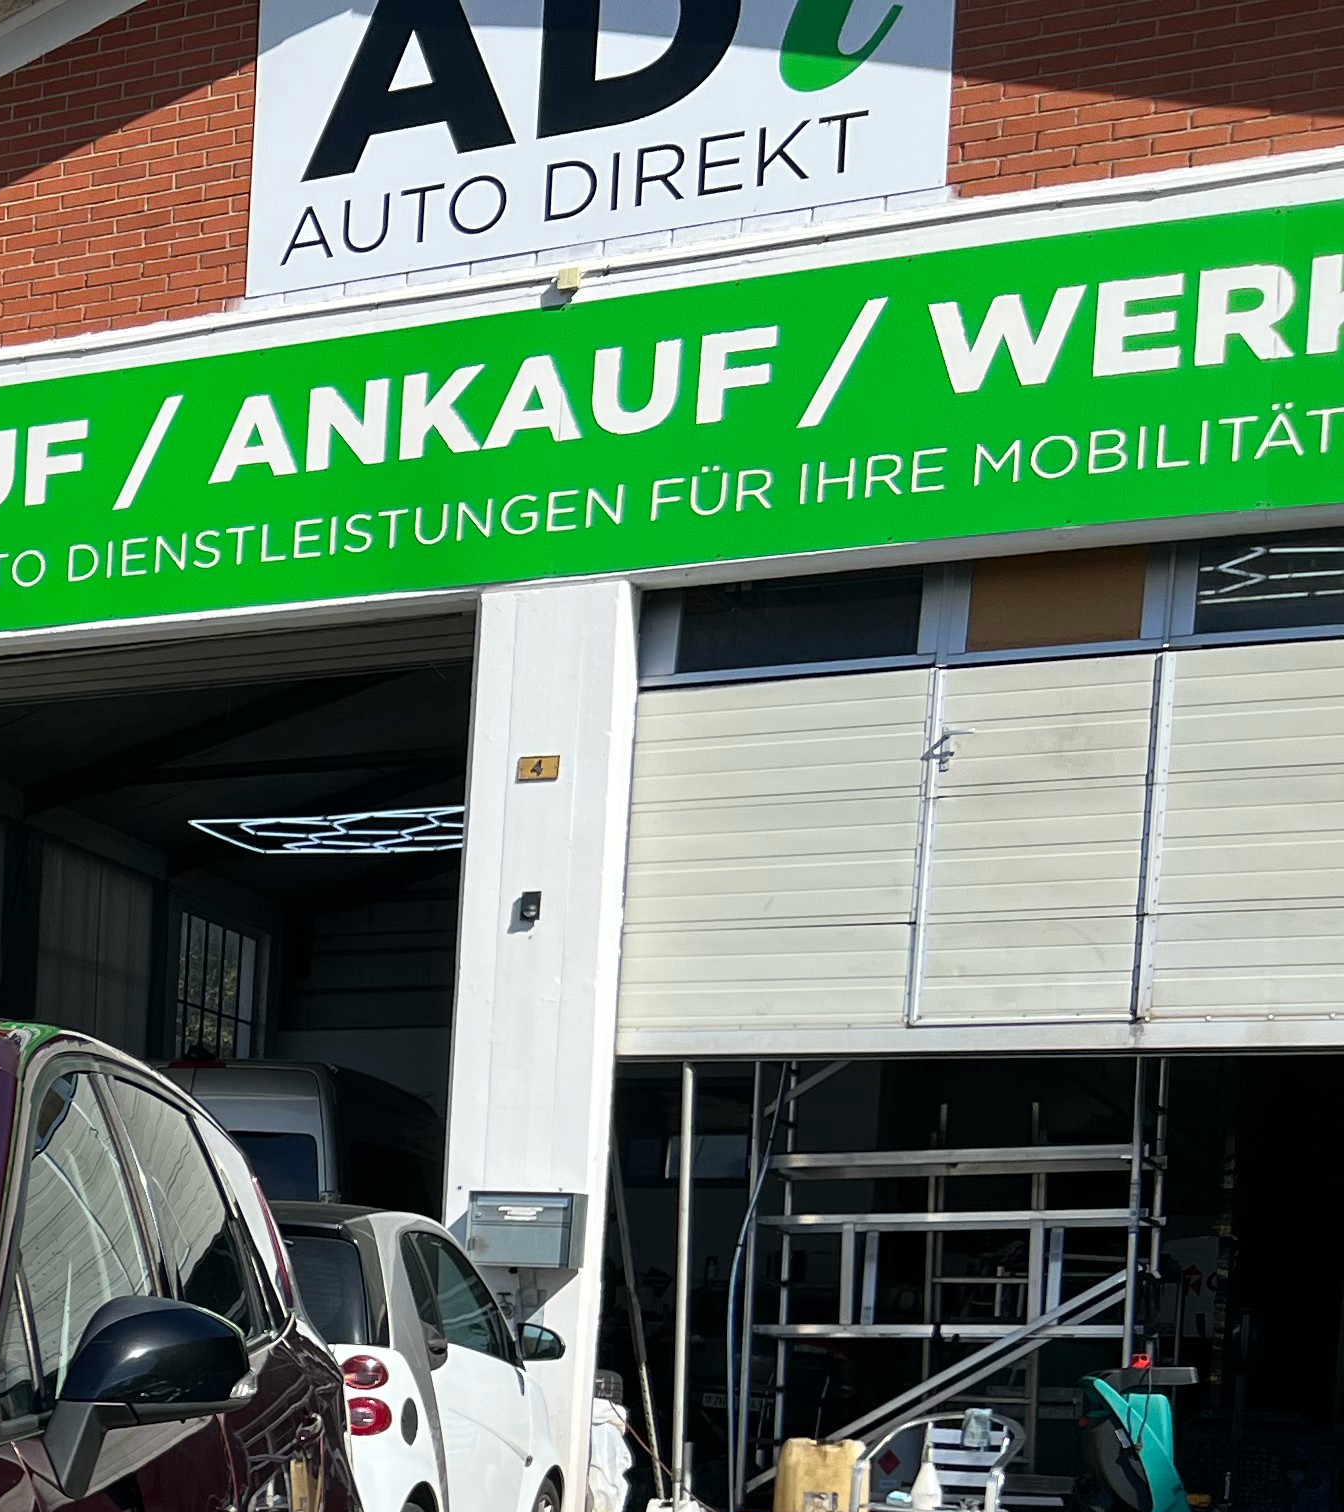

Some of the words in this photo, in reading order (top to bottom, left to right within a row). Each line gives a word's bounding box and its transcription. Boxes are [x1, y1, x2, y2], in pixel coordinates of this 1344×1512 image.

[279, 174, 509, 266] AUTO
[543, 109, 870, 222] DIREKT
[113, 395, 183, 511] /
[208, 326, 779, 484] ANKAUF
[796, 297, 889, 428] /
[67, 484, 625, 582] DIENSTLEISTUNGEN
[650, 466, 774, 521] FÜR
[799, 447, 948, 505] IHRE
[972, 402, 1344, 487] MOBILITÄT
[530, 759, 544, 777] 4
